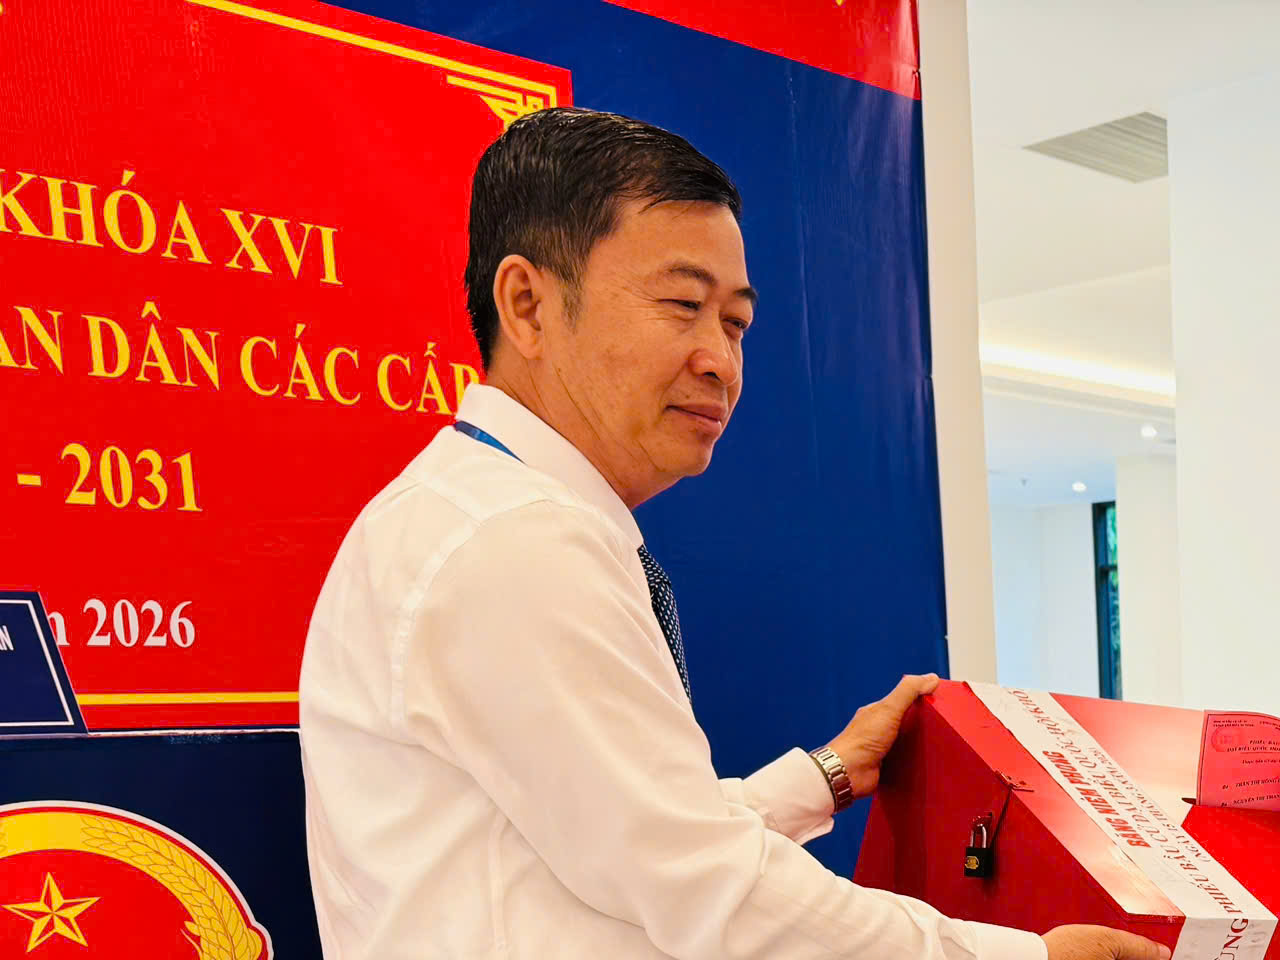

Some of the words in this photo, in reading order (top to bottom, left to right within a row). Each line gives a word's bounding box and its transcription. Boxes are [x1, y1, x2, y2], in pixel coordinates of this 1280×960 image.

[0, 169, 213, 265] KHÓA
[219, 208, 343, 286] XVI
[82, 301, 220, 391] DÂN
[239, 322, 361, 406] CÁC
[377, 341, 480, 416] CẤP
[60, 442, 203, 513] 2031
[83, 598, 196, 648] 2026
[1042, 750, 1091, 785] PHONG
